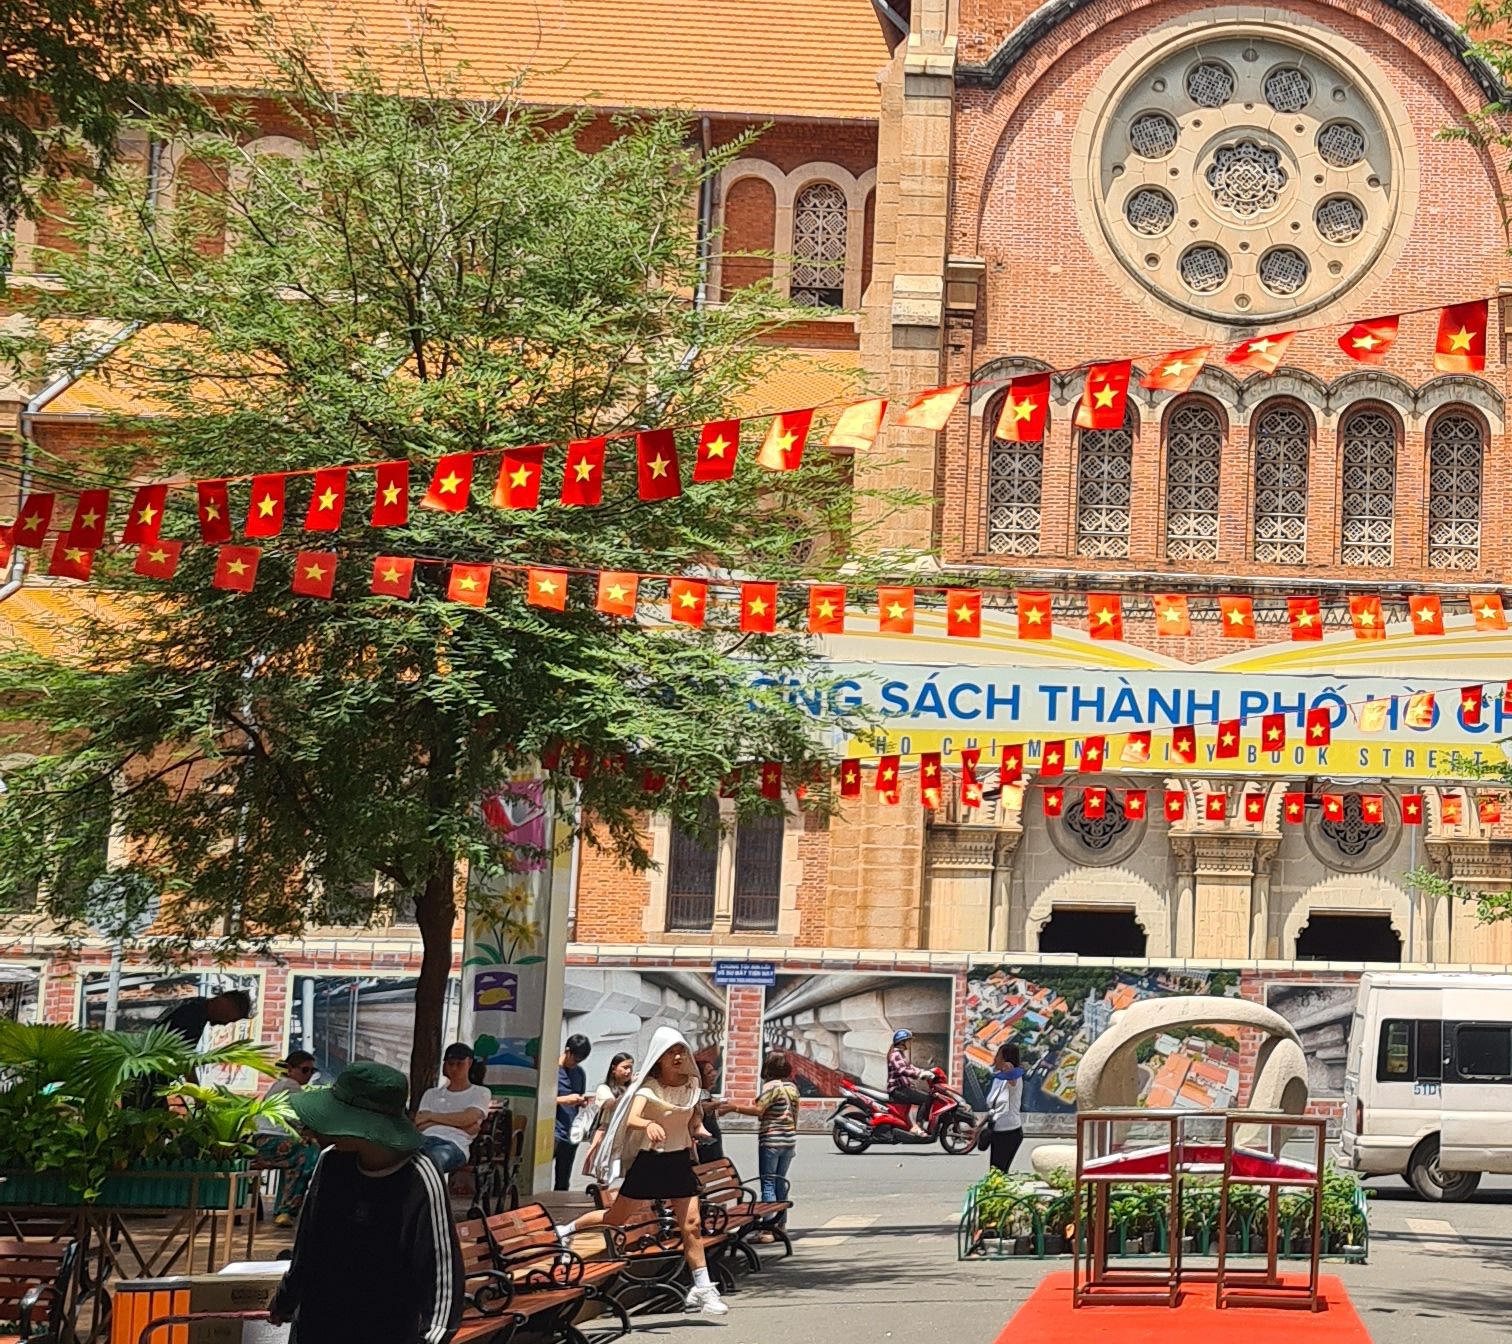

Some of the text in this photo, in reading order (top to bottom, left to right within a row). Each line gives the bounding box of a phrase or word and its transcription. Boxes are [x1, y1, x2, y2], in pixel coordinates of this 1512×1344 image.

[881, 671, 1020, 722] SÁCH
[1038, 677, 1220, 726] THÀNH
[1240, 684, 1349, 729] PHỐ
[876, 736, 911, 756] HO
[943, 737, 996, 757] CHI
[1028, 739, 1109, 760] MNH
[1248, 744, 1329, 766] BOOK
